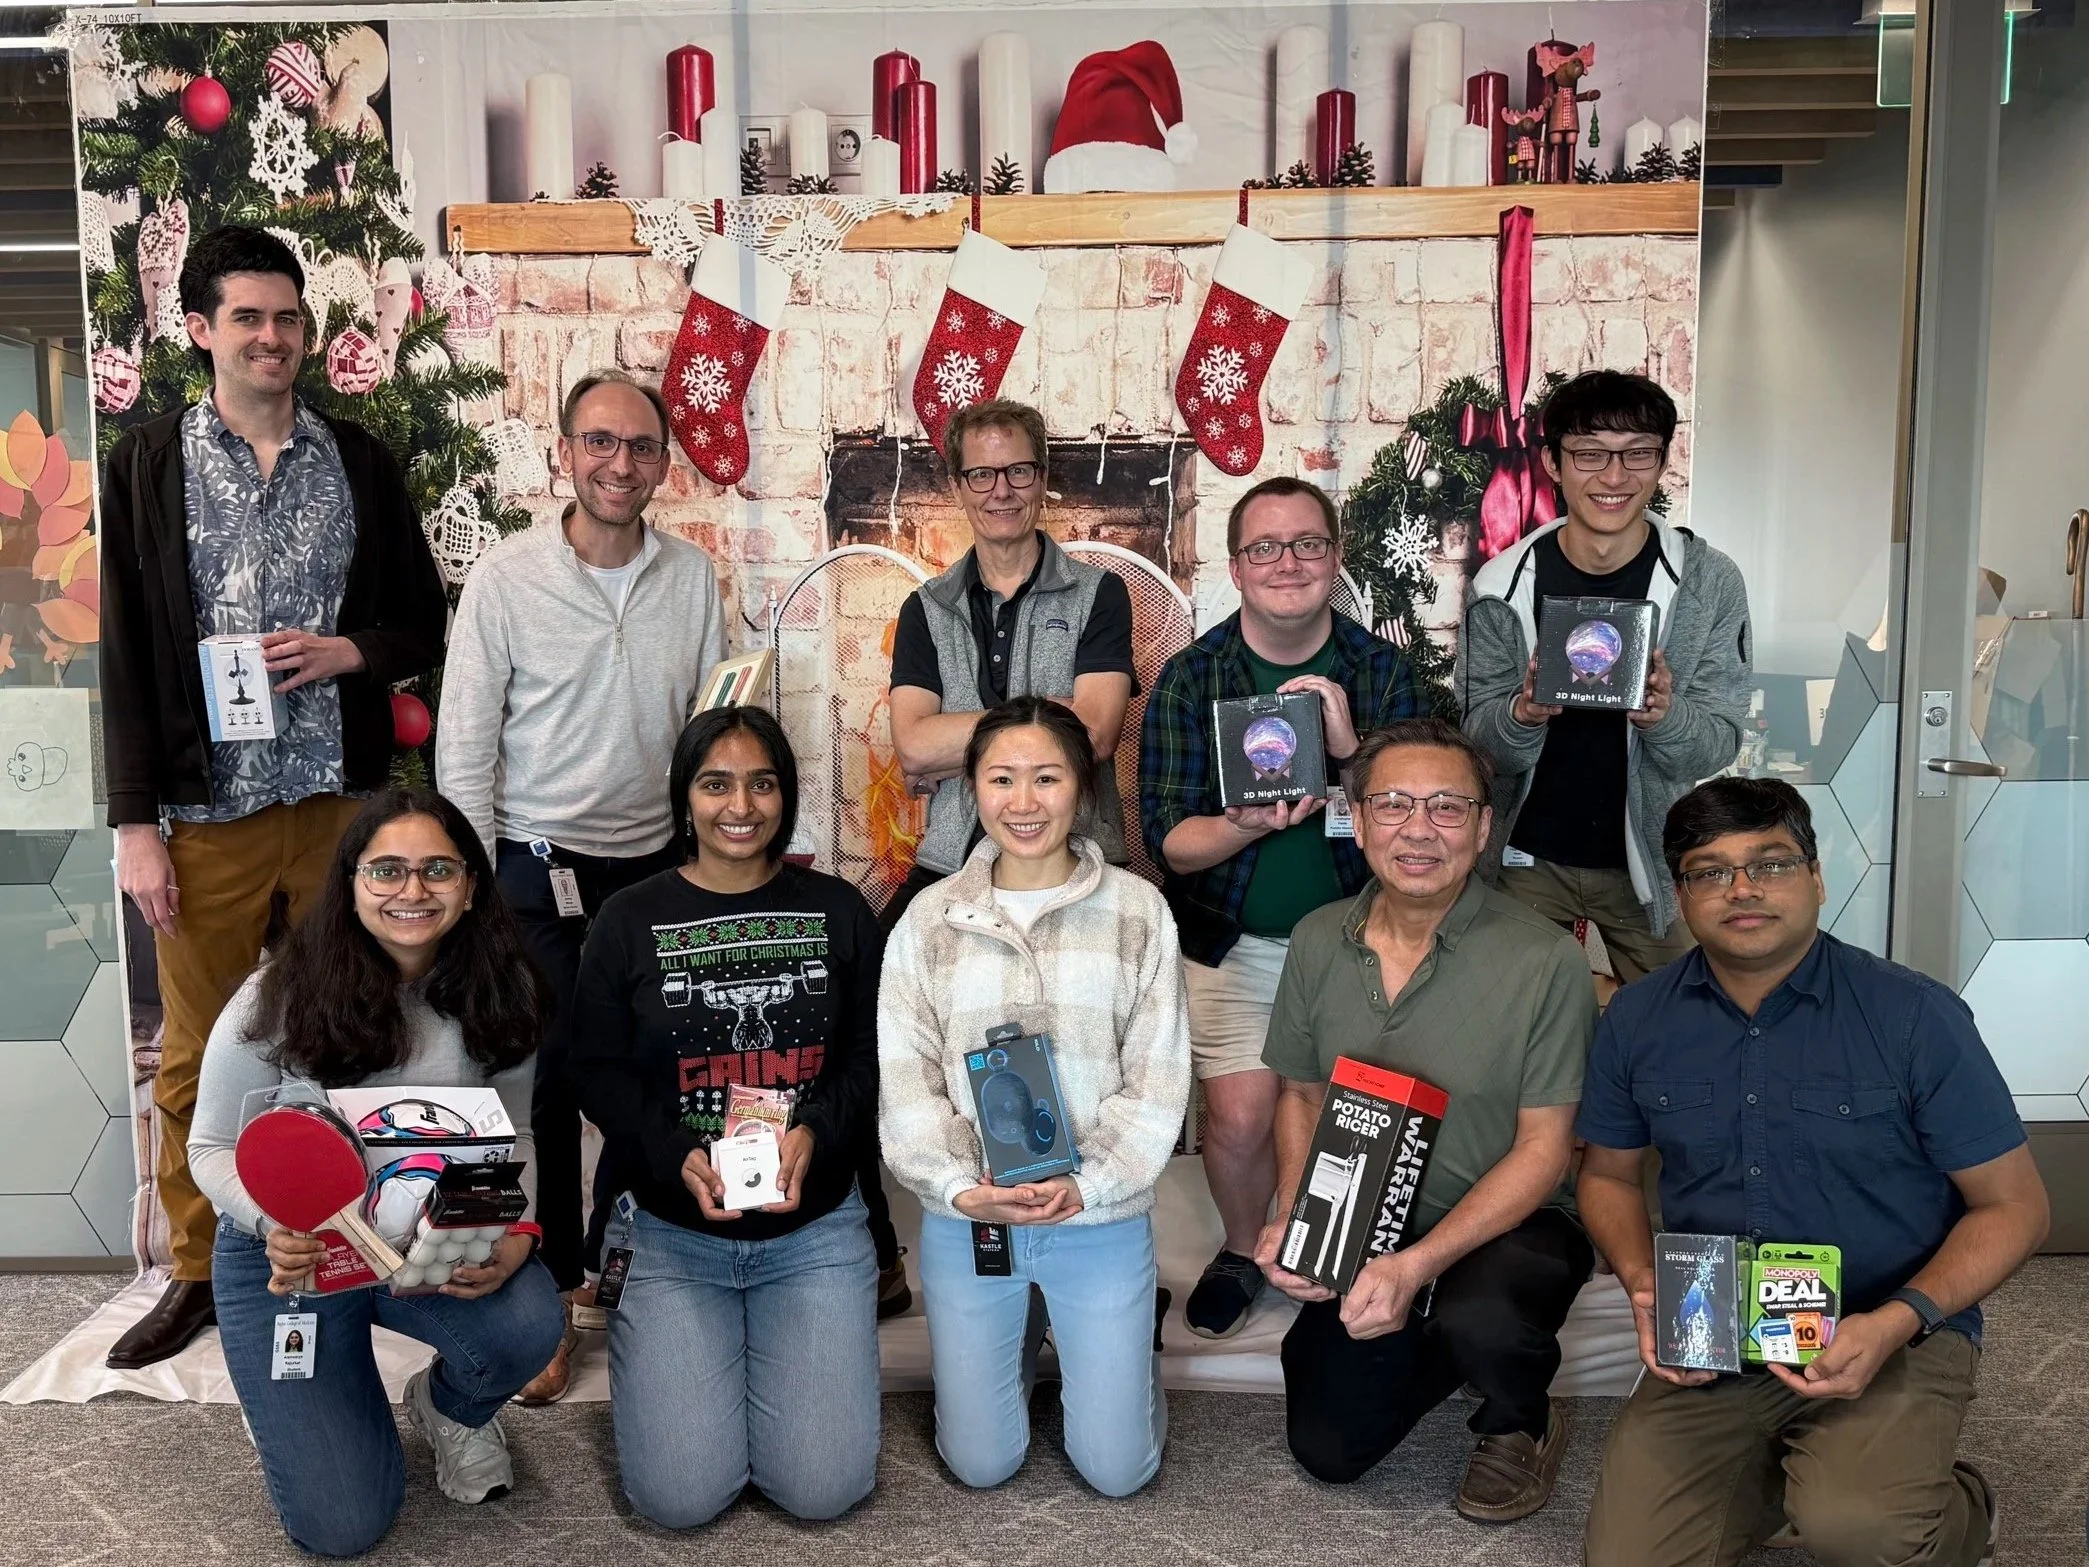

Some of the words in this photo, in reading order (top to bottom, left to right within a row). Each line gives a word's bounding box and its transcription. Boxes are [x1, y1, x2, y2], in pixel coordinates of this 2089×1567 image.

[104, 14, 142, 23] 10X10FT
[1571, 693, 1595, 702] Night
[1598, 695, 1621, 703] Light
[1244, 791, 1255, 799] 3D
[1258, 790, 1281, 798] Night
[1284, 787, 1306, 796] Light
[660, 957, 680, 970] ALL
[683, 956, 687, 968] I
[690, 950, 722, 967] WANT
[726, 948, 748, 962] FOR
[751, 943, 814, 960] CHRISTMAS
[817, 942, 828, 956] IS
[678, 1045, 825, 1092] GAINS
[1343, 1091, 1371, 1105] Stainless
[1372, 1100, 1389, 1111] Steel
[479, 1109, 504, 1134] 5
[1332, 1098, 1392, 1128] POTATO
[1335, 1114, 1380, 1139] RICER
[1365, 1116, 1424, 1264] WARRAN
[1383, 1139, 1429, 1255] LIFETIM
[327, 1256, 358, 1269] TABLE
[1665, 1253, 1695, 1262] STORM
[1696, 1255, 1725, 1264] GLASS
[319, 1264, 352, 1279] TENNIS
[1765, 1269, 1818, 1279] MONOPOLY
[1758, 1278, 1827, 1303] DEAL
[1796, 1327, 1816, 1341] 10
